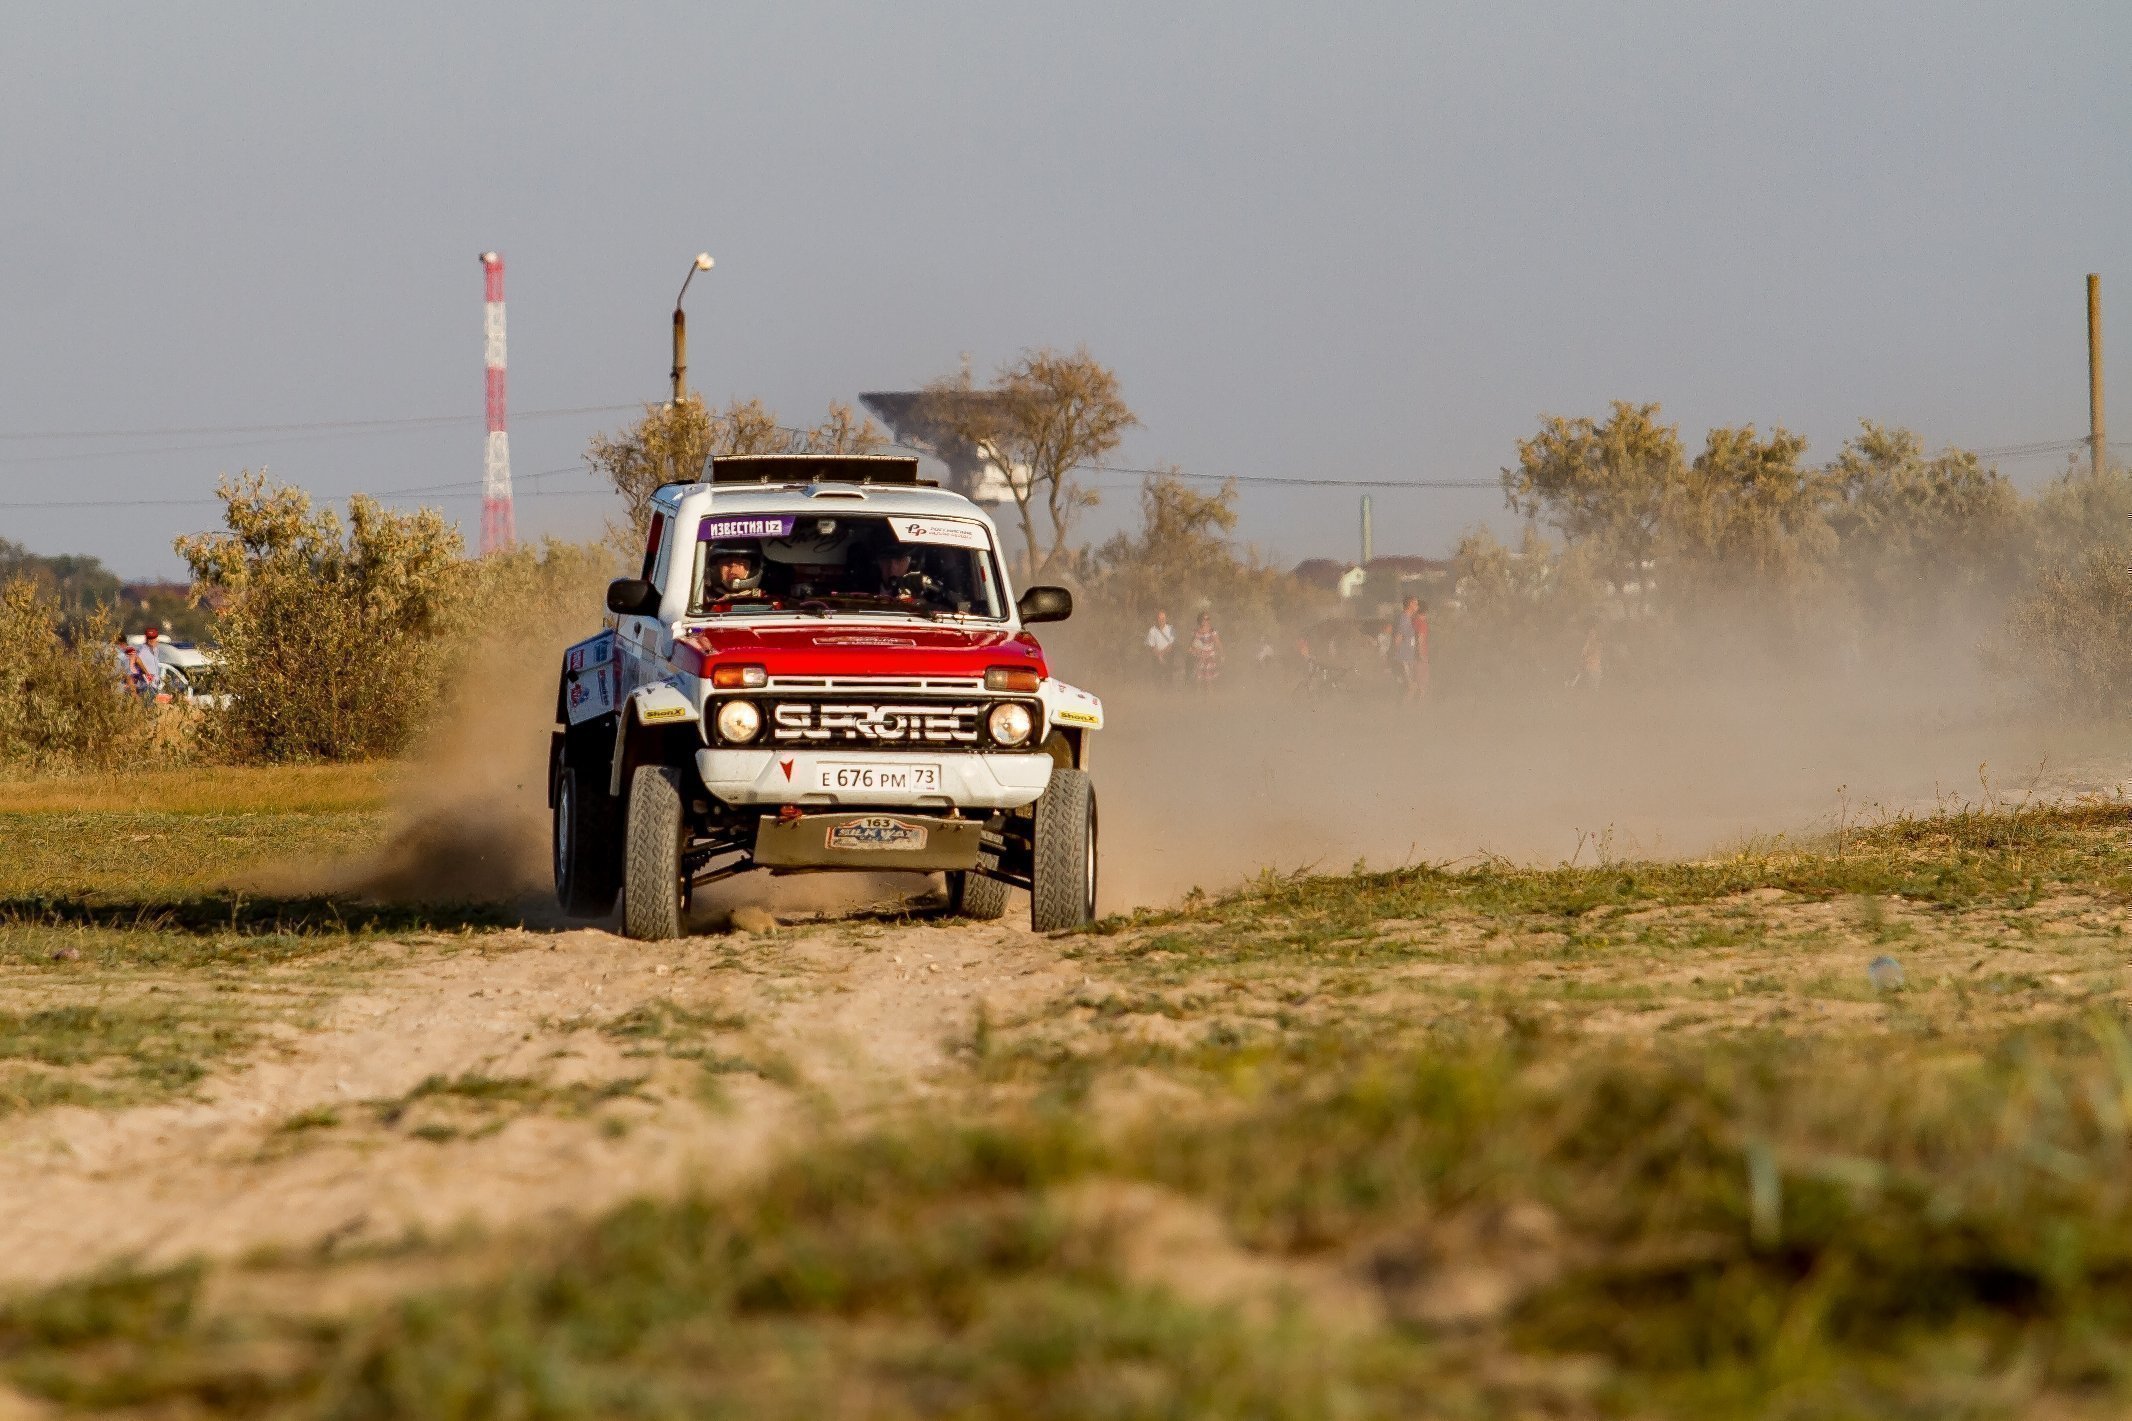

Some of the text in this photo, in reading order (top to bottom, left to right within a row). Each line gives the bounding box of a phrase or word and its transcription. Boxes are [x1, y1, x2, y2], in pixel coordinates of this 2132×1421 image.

[710, 521, 763, 536] ИЗВЕСТИЯ
[837, 769, 873, 787] 676
[914, 769, 934, 784] 73
[866, 819, 891, 827] 163
[838, 828, 876, 839] SILK
